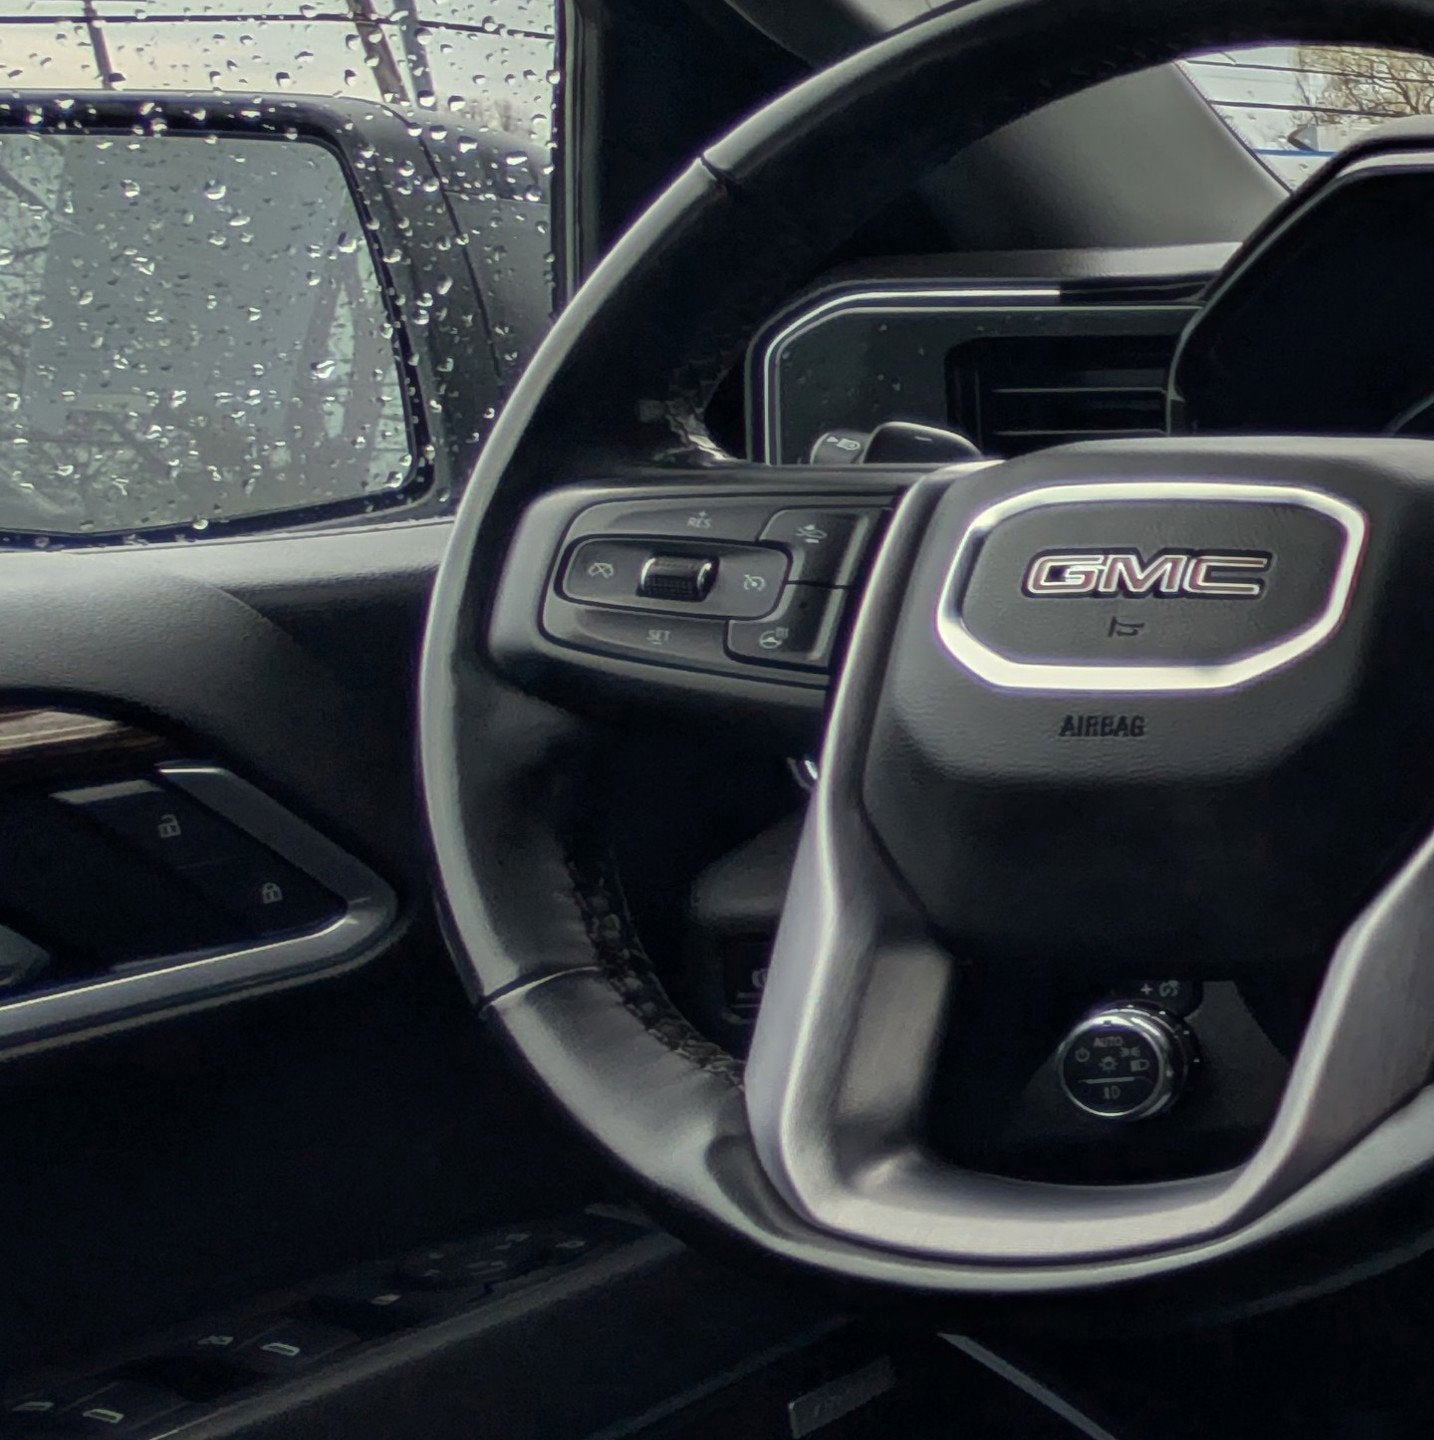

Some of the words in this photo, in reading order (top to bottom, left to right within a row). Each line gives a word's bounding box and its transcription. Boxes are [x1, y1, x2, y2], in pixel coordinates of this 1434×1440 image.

[1026, 553, 1271, 597] GMC
[1058, 714, 1146, 739] AIRBAG
[1093, 1035, 1124, 1049] AUTO
